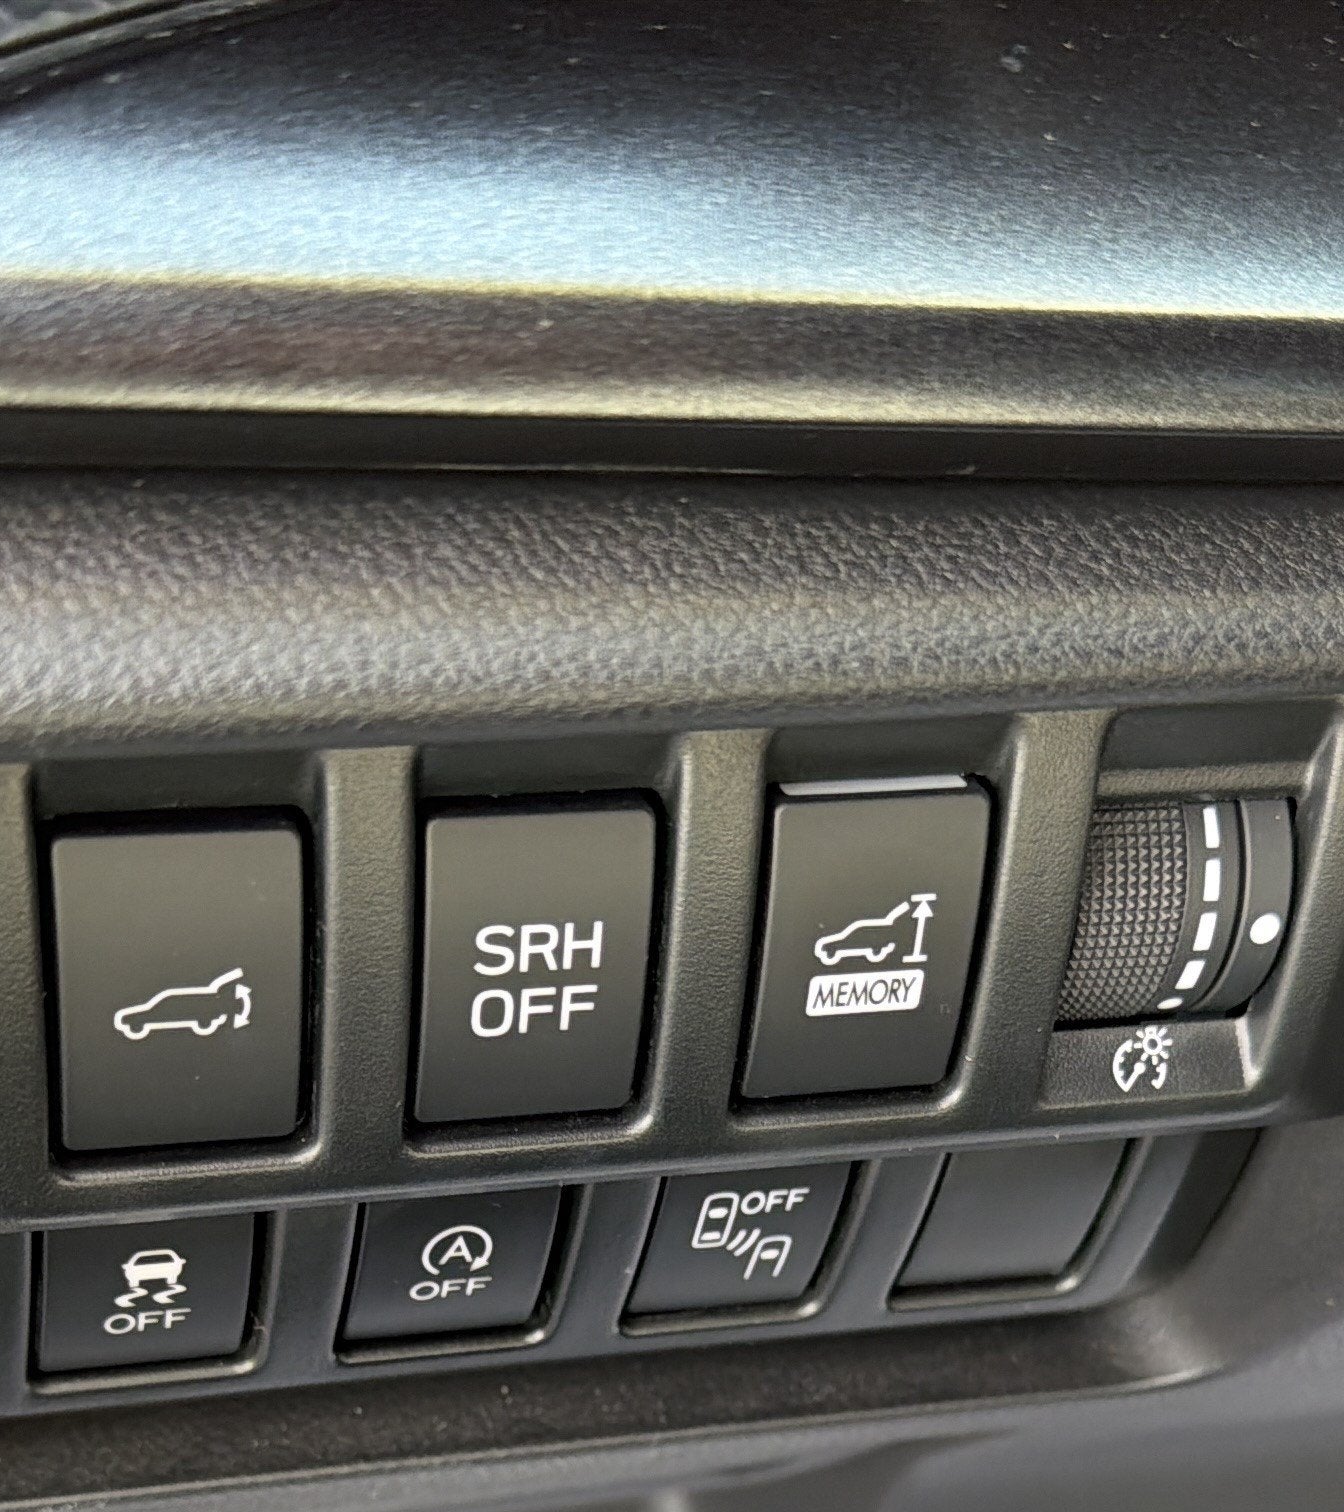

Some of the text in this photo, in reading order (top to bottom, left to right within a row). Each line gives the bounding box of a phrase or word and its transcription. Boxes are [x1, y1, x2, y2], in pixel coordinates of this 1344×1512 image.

[472, 919, 605, 977] SRH
[812, 976, 917, 1009] MEMORY
[469, 983, 599, 1038] OFF
[740, 1186, 810, 1215] OFF
[409, 1276, 493, 1301] OFF
[103, 1307, 192, 1335] OFF
